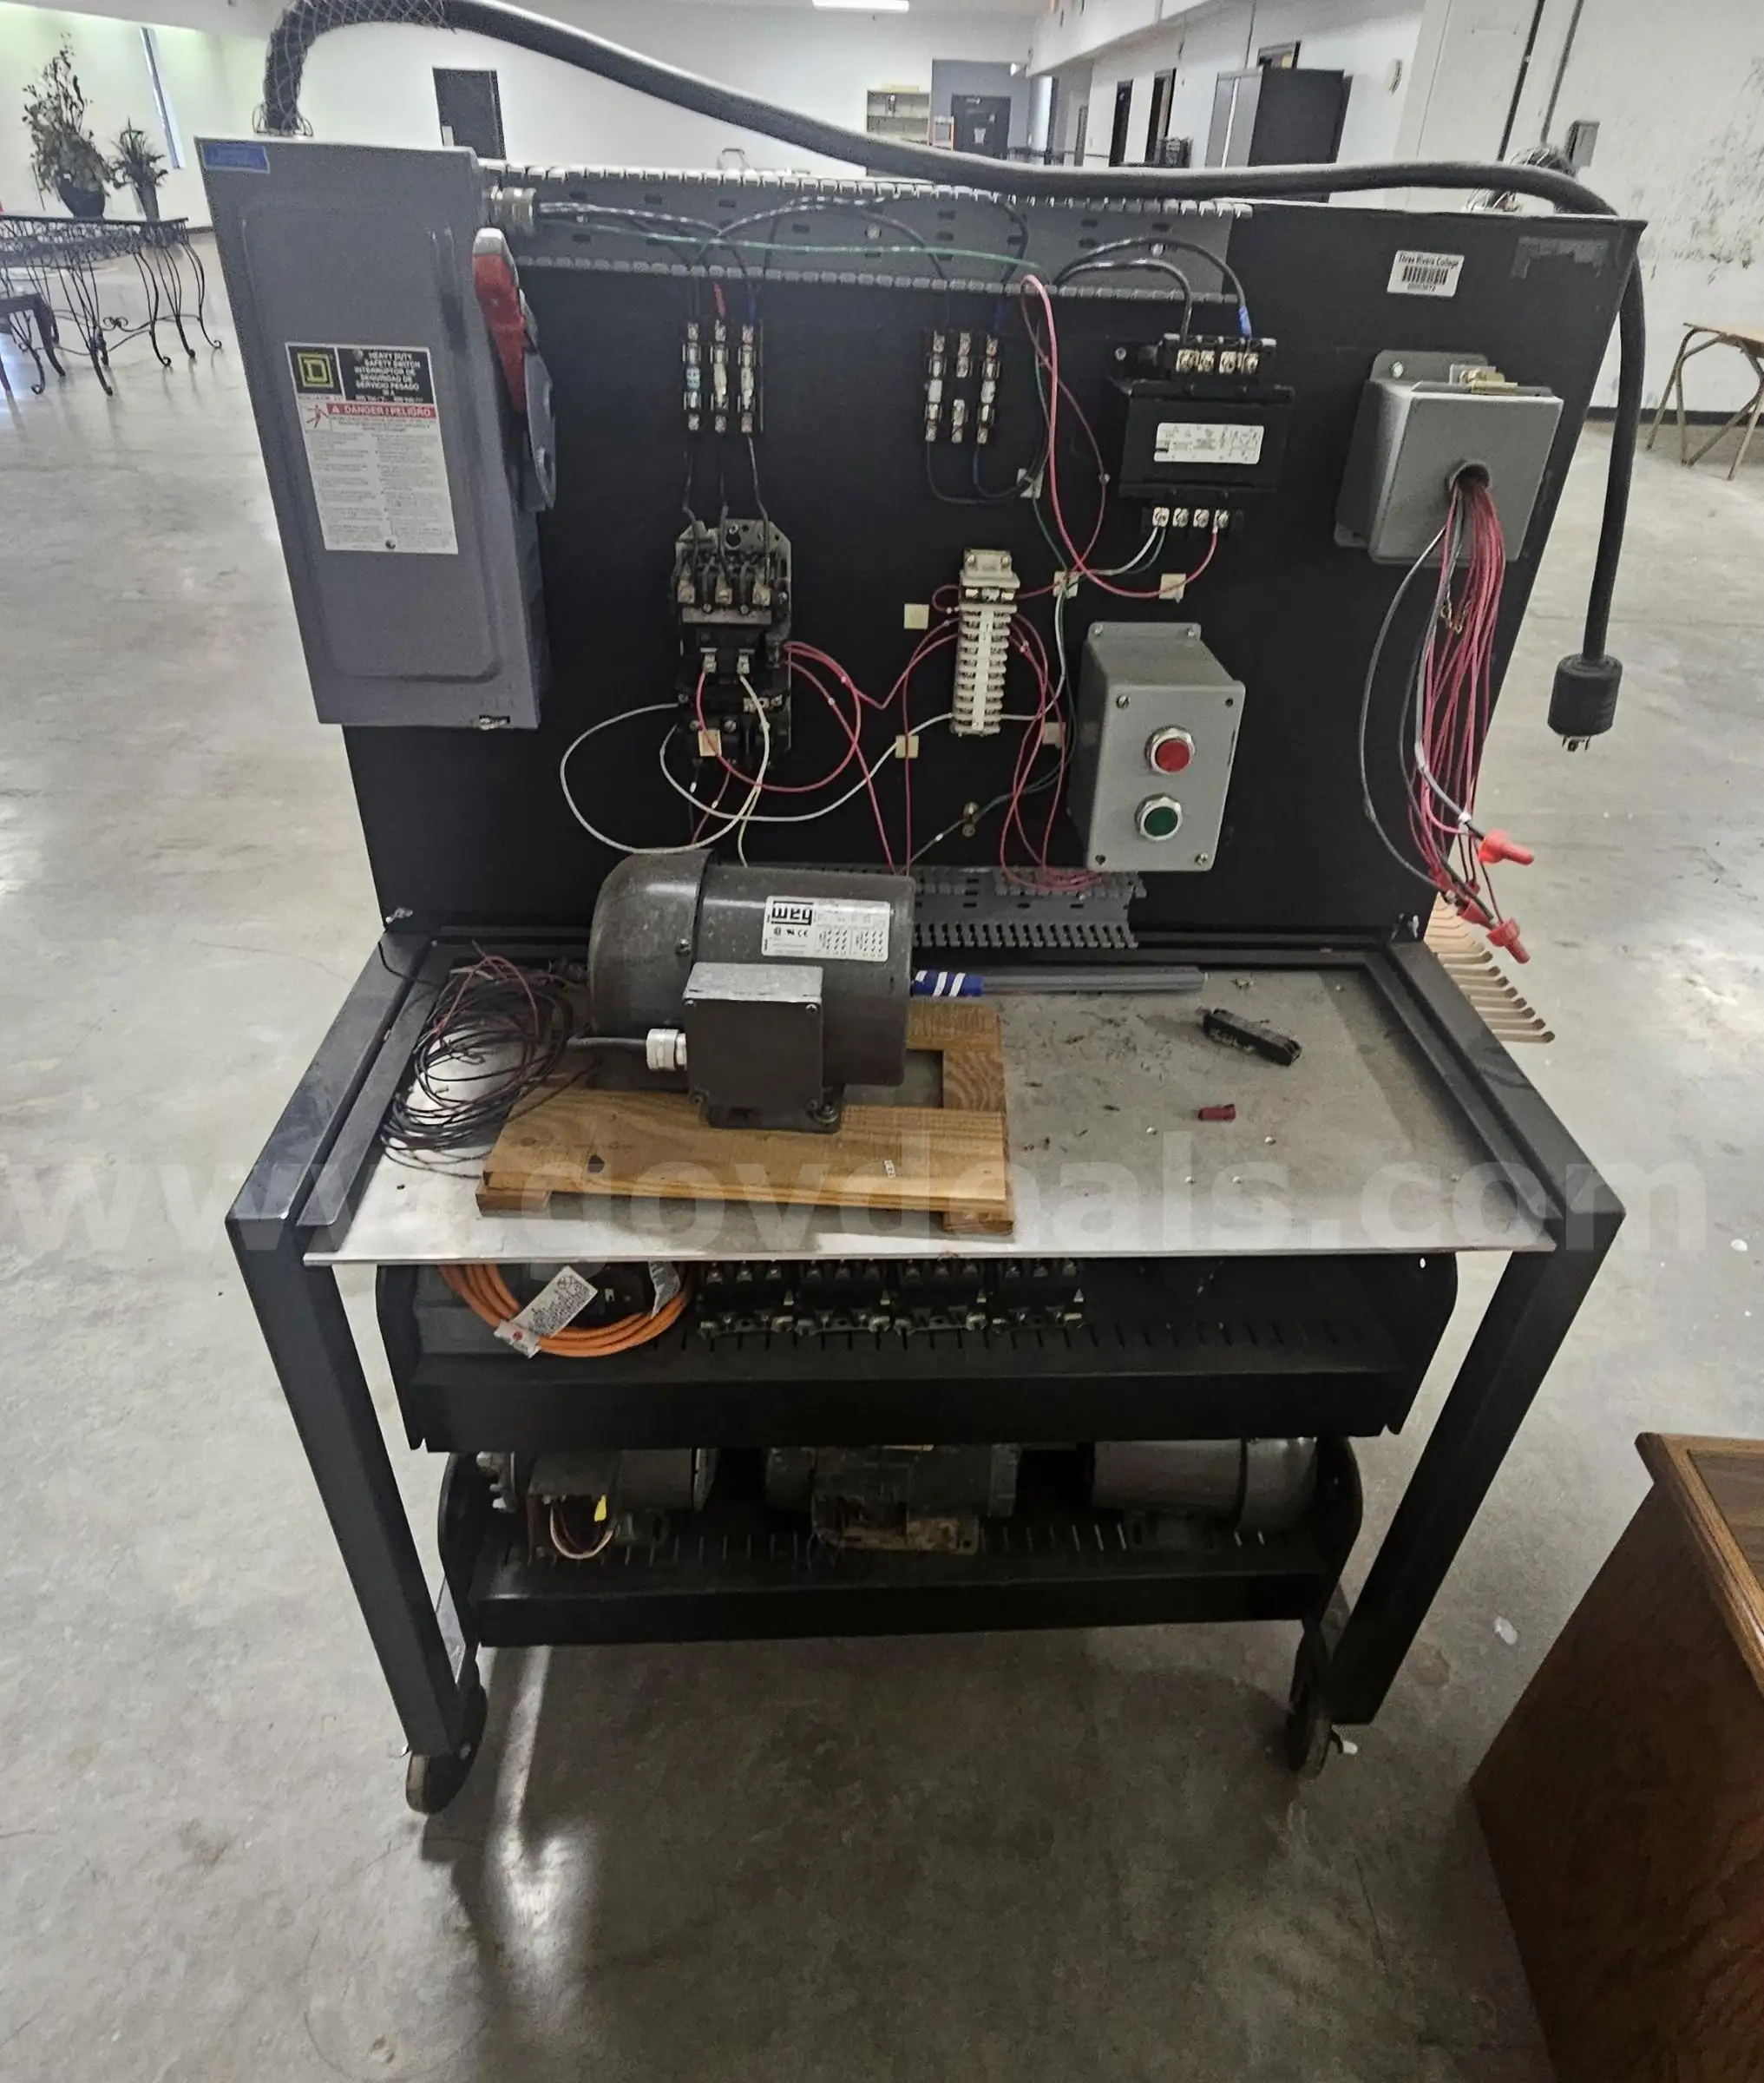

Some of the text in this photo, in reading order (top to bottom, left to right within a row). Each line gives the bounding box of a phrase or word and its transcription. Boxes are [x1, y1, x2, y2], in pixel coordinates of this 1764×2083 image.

[1399, 253, 1415, 264] Three
[1436, 256, 1459, 270] College
[394, 352, 413, 361] DUTY
[390, 382, 420, 391] PESADO
[344, 404, 384, 416] DANGER
[390, 405, 431, 417] PELIGRO
